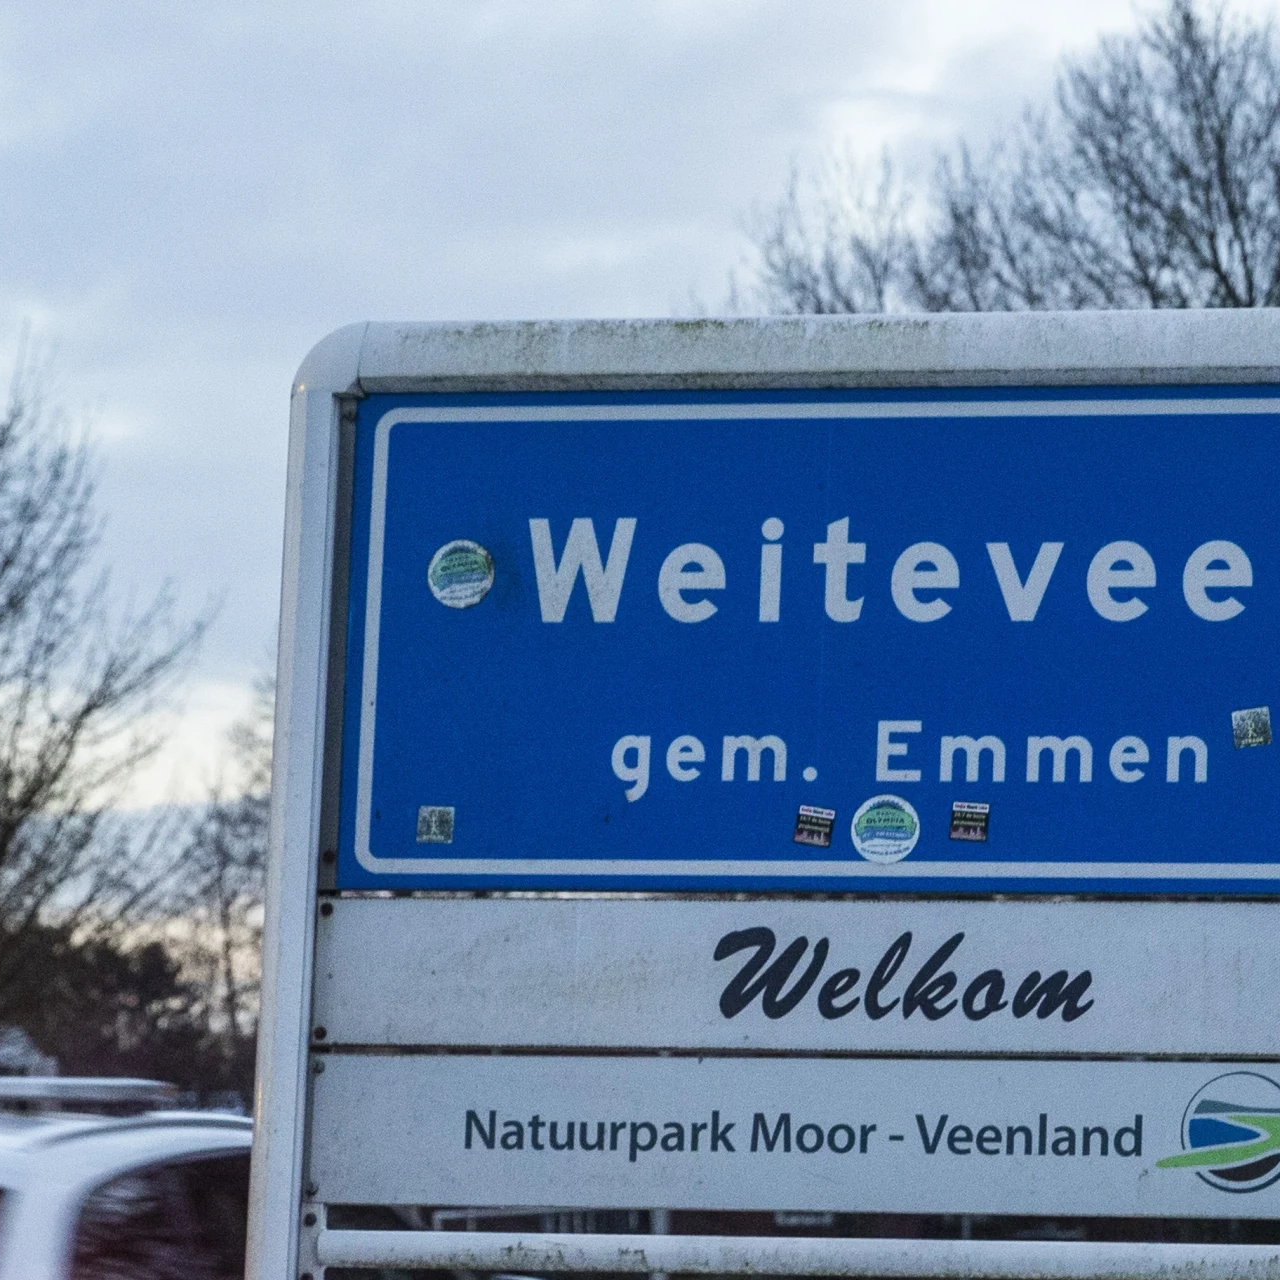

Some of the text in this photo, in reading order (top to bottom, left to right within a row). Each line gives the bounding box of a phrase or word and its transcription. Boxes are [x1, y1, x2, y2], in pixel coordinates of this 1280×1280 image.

[612, 721, 1208, 802] gem. Emmen
[712, 926, 1095, 1023] Welkom
[464, 1109, 736, 1163] Natuurpark
[750, 1112, 877, 1155] Moor
[915, 1113, 1143, 1158] Veenland
